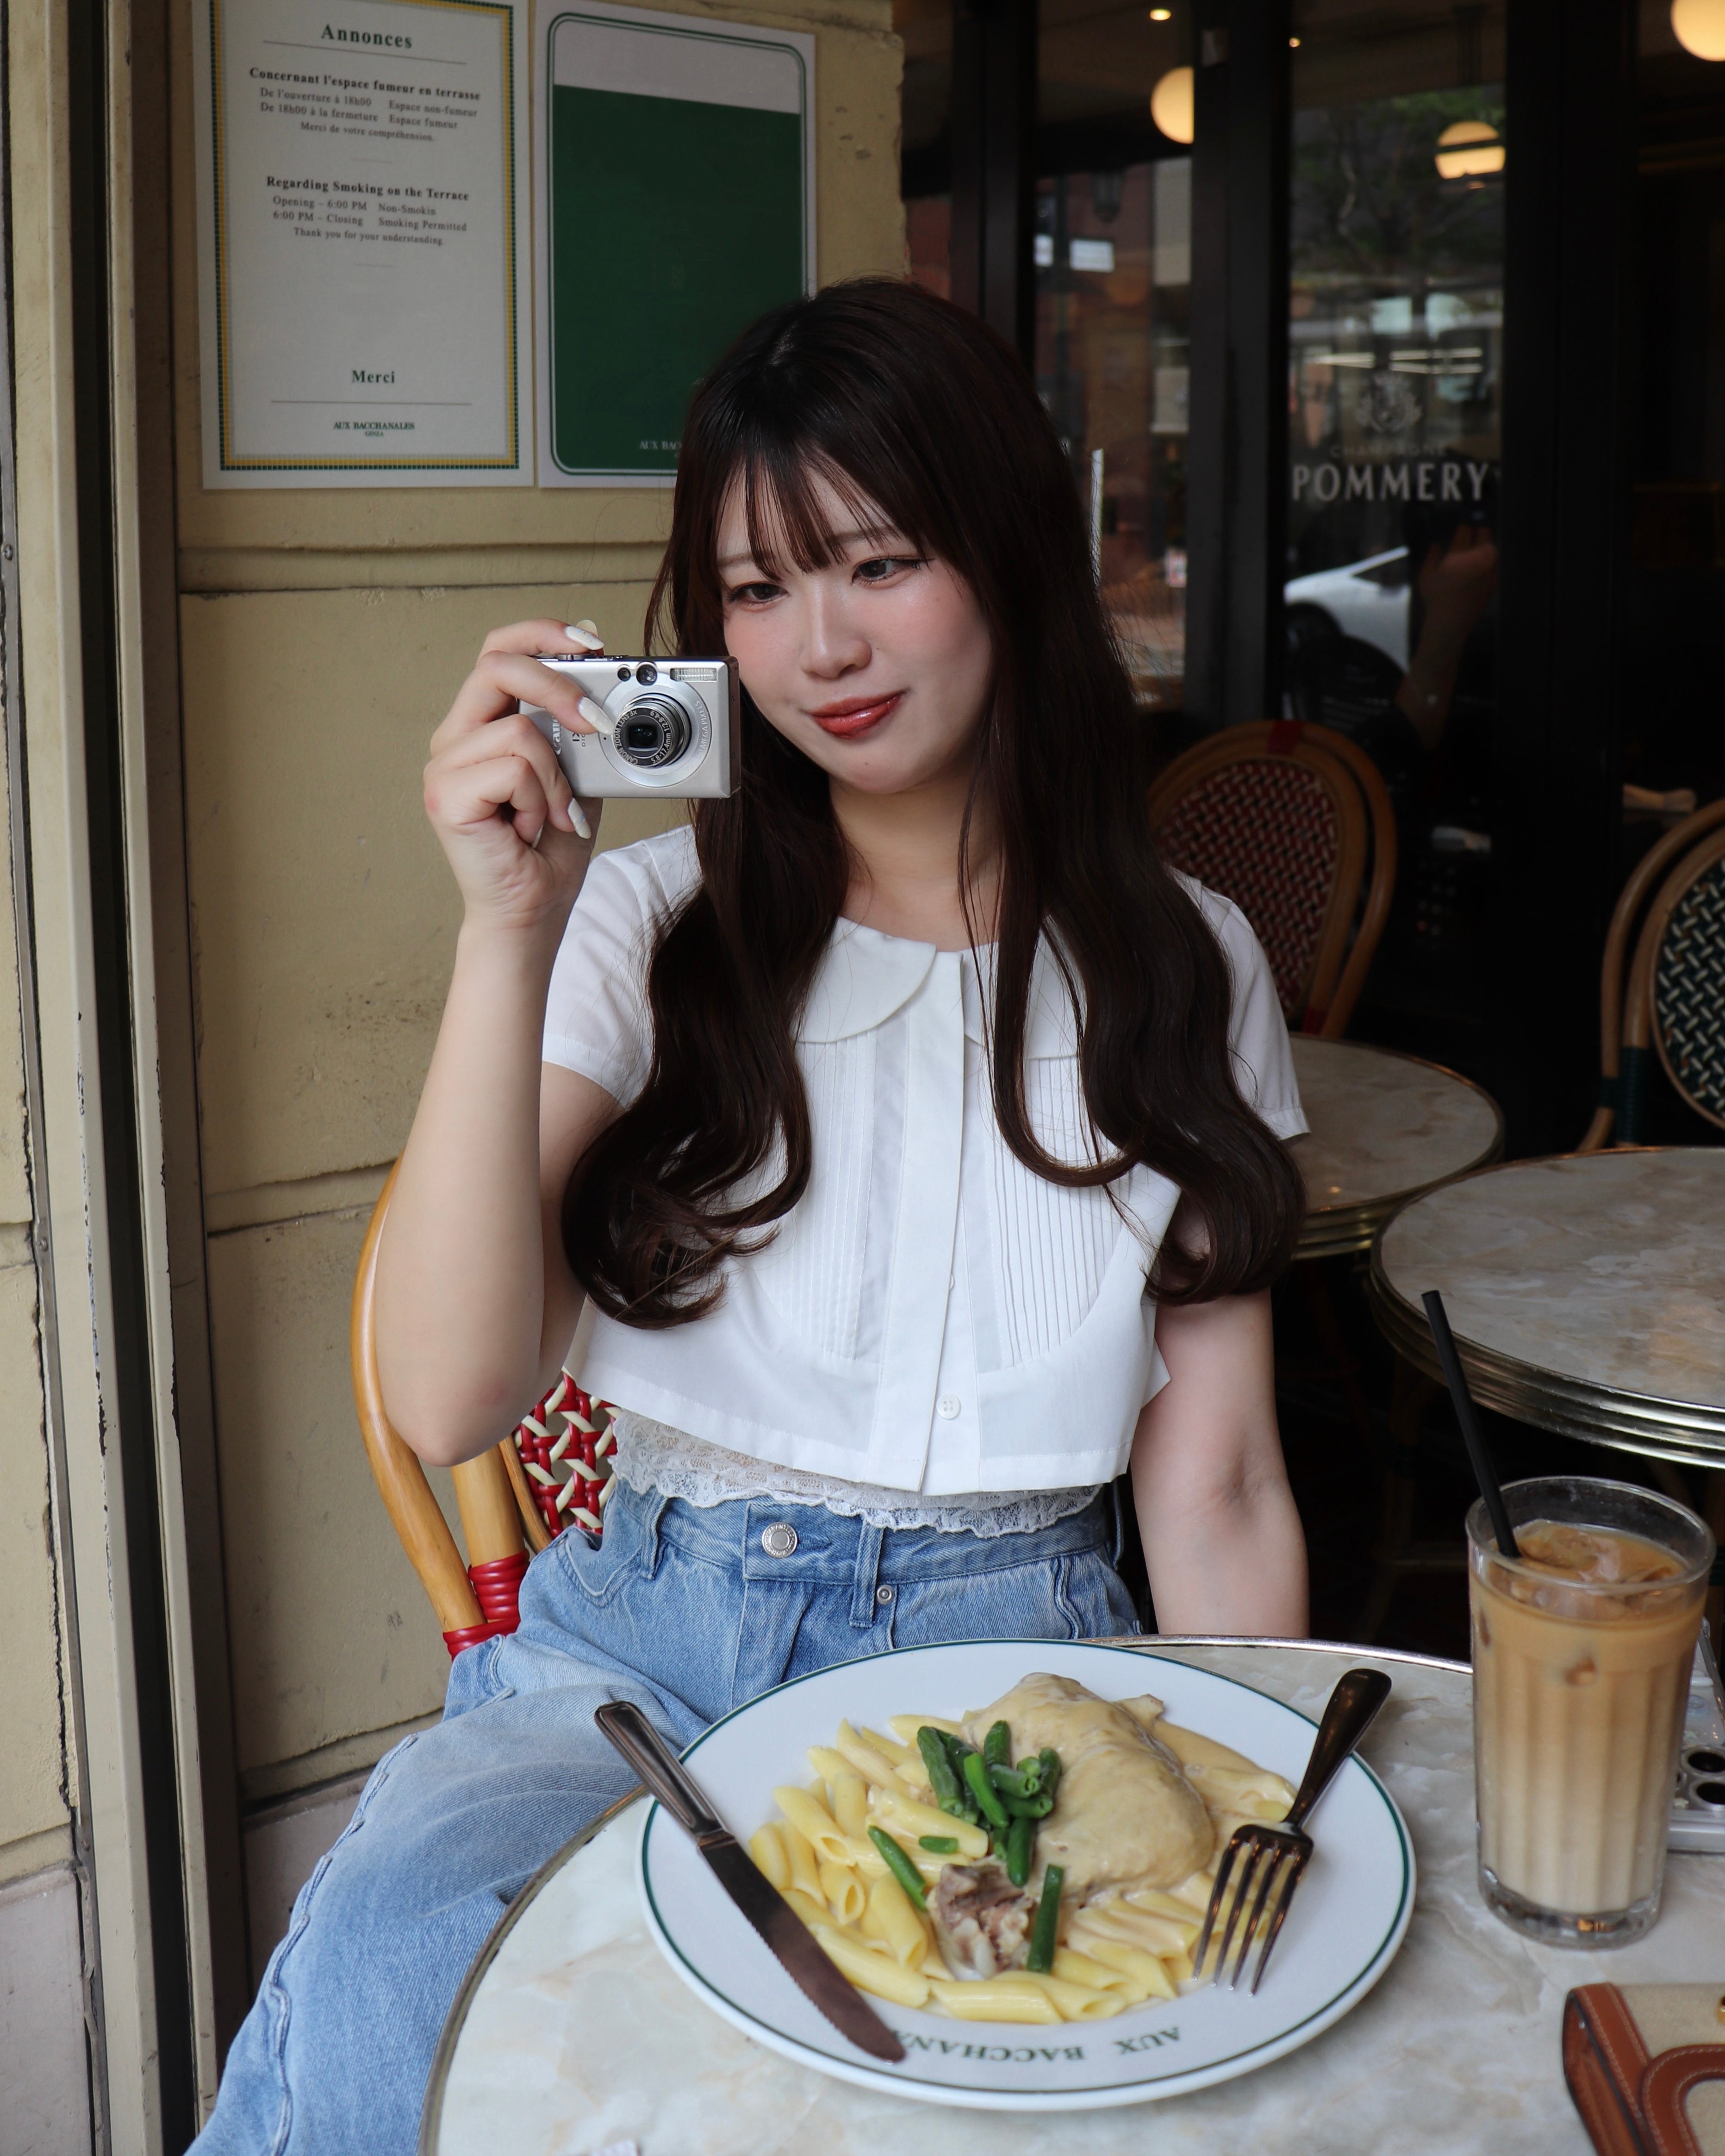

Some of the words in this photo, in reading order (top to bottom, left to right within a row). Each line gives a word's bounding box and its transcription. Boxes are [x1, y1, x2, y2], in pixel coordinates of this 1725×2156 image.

[321, 24, 412, 49] Annonces
[249, 67, 319, 84] Concernant
[324, 75, 369, 89] l'espace
[374, 79, 415, 93] fumeur
[436, 87, 481, 100] terrasse
[260, 87, 274, 97] De
[278, 88, 331, 103] l'ouverture
[335, 95, 340, 103] à
[344, 95, 372, 106] 18h00
[389, 99, 421, 112] Espace
[424, 105, 478, 117] non-fumeur
[261, 101, 274, 112] De
[279, 104, 307, 114] 18h00
[311, 106, 316, 115] à
[319, 107, 328, 117] la
[332, 109, 378, 121] fermeture
[389, 114, 421, 126] Espace
[425, 118, 458, 129] fumeur
[301, 121, 327, 131] Merci
[330, 124, 340, 132] de
[343, 126, 366, 135] votre
[267, 176, 329, 193] Regarding
[333, 180, 383, 197] Smoking
[387, 187, 400, 195] on
[405, 186, 422, 198] the
[426, 188, 469, 200] Terrace
[273, 195, 315, 208] Opening
[327, 199, 348, 209] 6:00
[352, 201, 367, 211] PM
[378, 203, 436, 215] Non-Smokin
[273, 210, 294, 220] 6:00
[299, 211, 314, 221] PM
[326, 214, 363, 226] Closing
[378, 217, 419, 230] Smoking
[423, 219, 467, 231] Permitted
[293, 227, 322, 236] Thank
[325, 231, 341, 239] you
[344, 230, 356, 239] for
[360, 233, 380, 241] your
[351, 370, 396, 383] Merci
[639, 441, 658, 449] AUX
[1291, 464, 1489, 501] POMMERY
[618, 714, 629, 727] LENS
[618, 747, 638, 764] CANON
[1115, 2027, 1181, 2056] AUX
